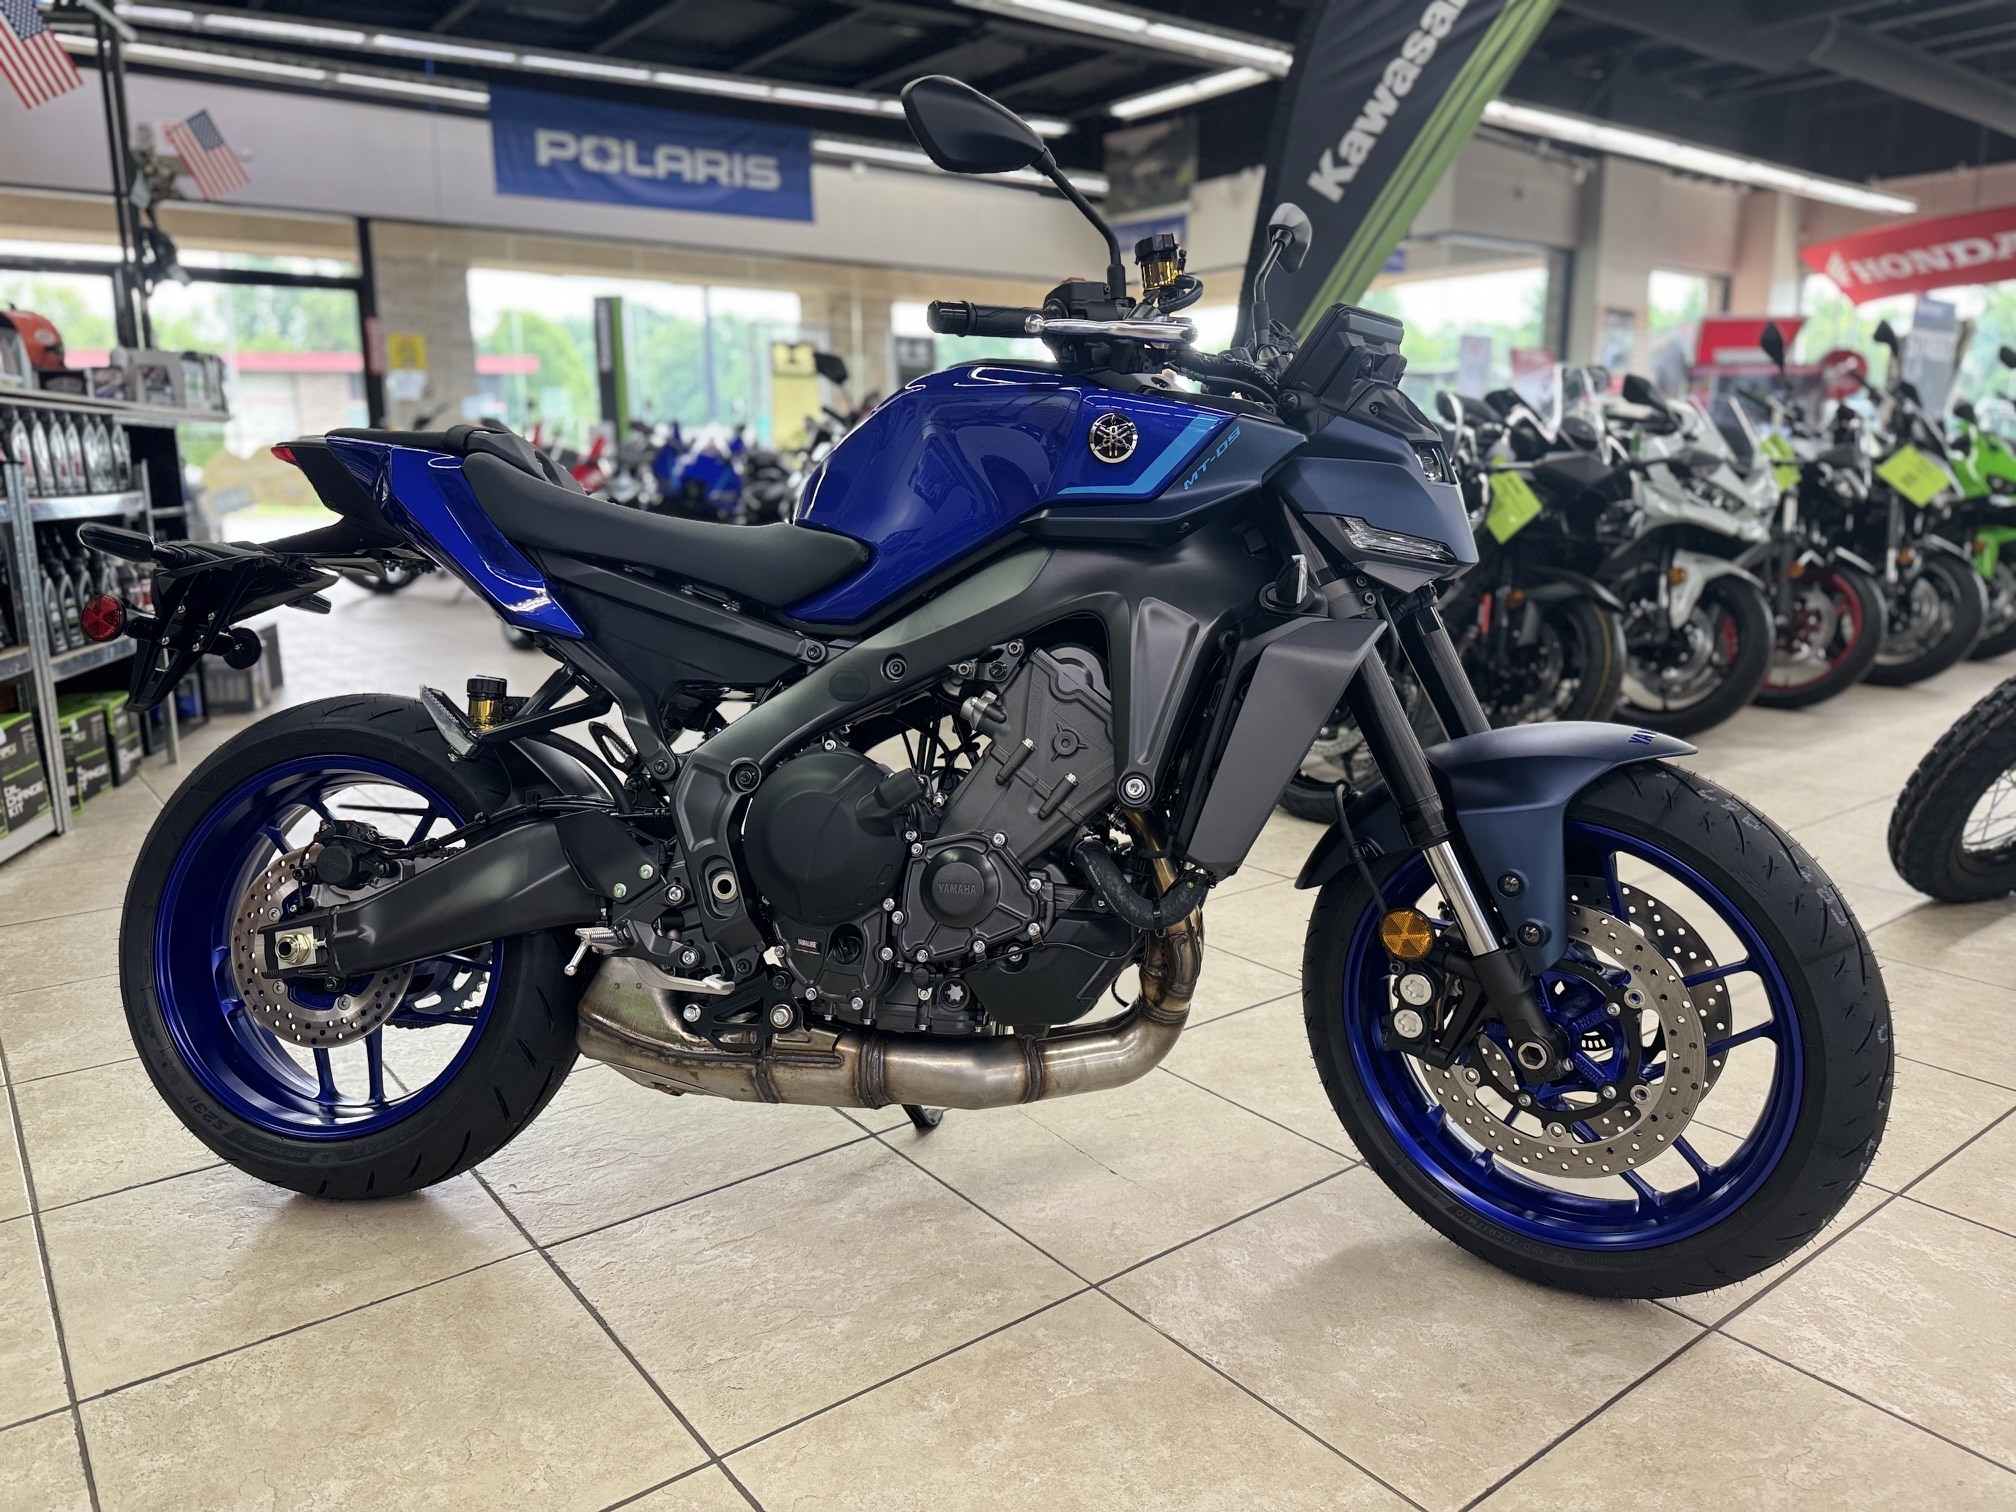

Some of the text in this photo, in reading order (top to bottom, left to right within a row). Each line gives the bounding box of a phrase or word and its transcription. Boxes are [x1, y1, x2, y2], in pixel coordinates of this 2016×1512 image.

[1307, 0, 1468, 203] Kawasa
[534, 128, 782, 191] POLARIS
[1183, 425, 1242, 491] MT-09
[8, 801, 24, 819] KIT
[938, 883, 977, 895] YAMAHA
